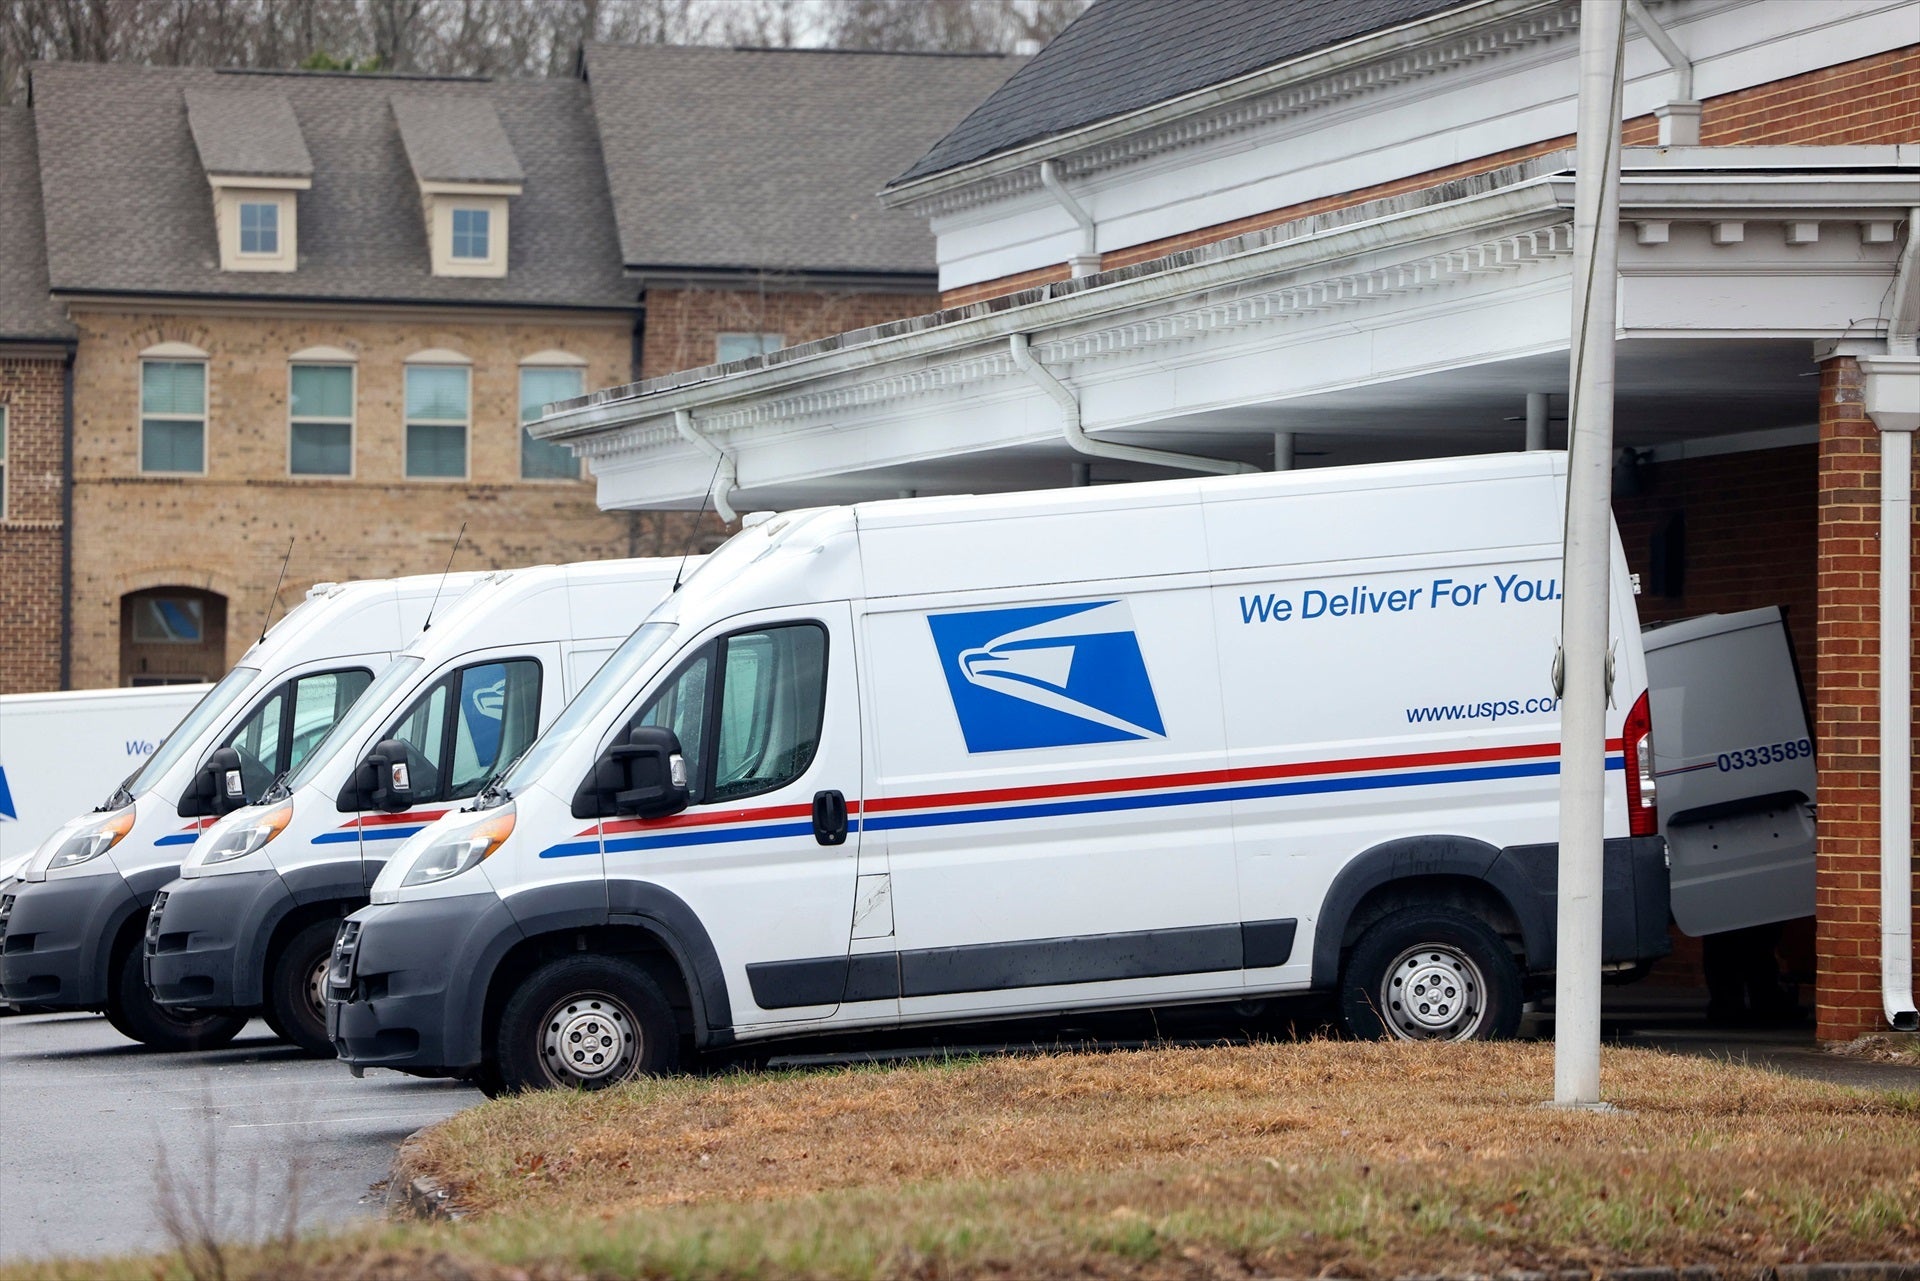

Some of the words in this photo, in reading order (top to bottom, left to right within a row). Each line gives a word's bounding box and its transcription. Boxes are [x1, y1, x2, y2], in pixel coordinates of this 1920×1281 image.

[1239, 592, 1294, 625] We
[1301, 584, 1424, 621] Deliver
[1430, 578, 1489, 609] For
[1493, 573, 1562, 604] You.
[126, 740, 154, 755] We
[1717, 739, 1812, 772] 0333589
